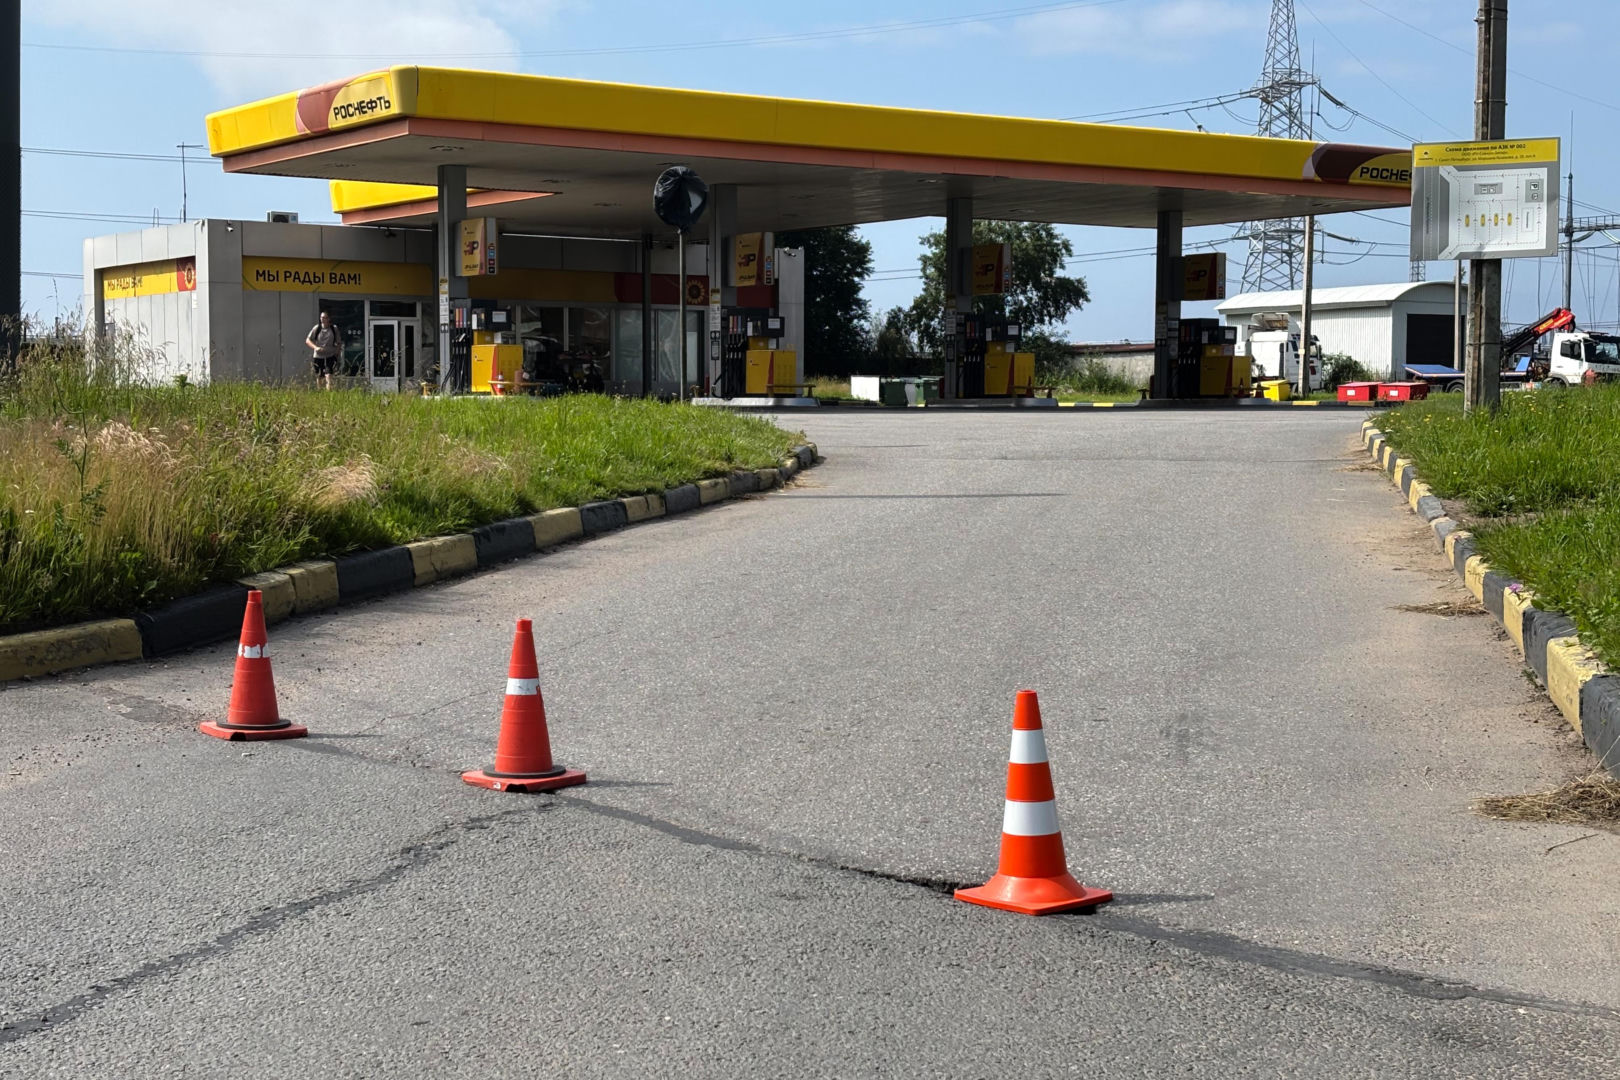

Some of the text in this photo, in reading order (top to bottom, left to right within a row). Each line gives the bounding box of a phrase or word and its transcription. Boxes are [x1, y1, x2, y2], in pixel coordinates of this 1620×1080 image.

[333, 96, 391, 121] РОСНЕФТЬ
[1359, 166, 1412, 181] РОСНЕ
[255, 269, 361, 285] МЫ РАДЫ ВАМ!
